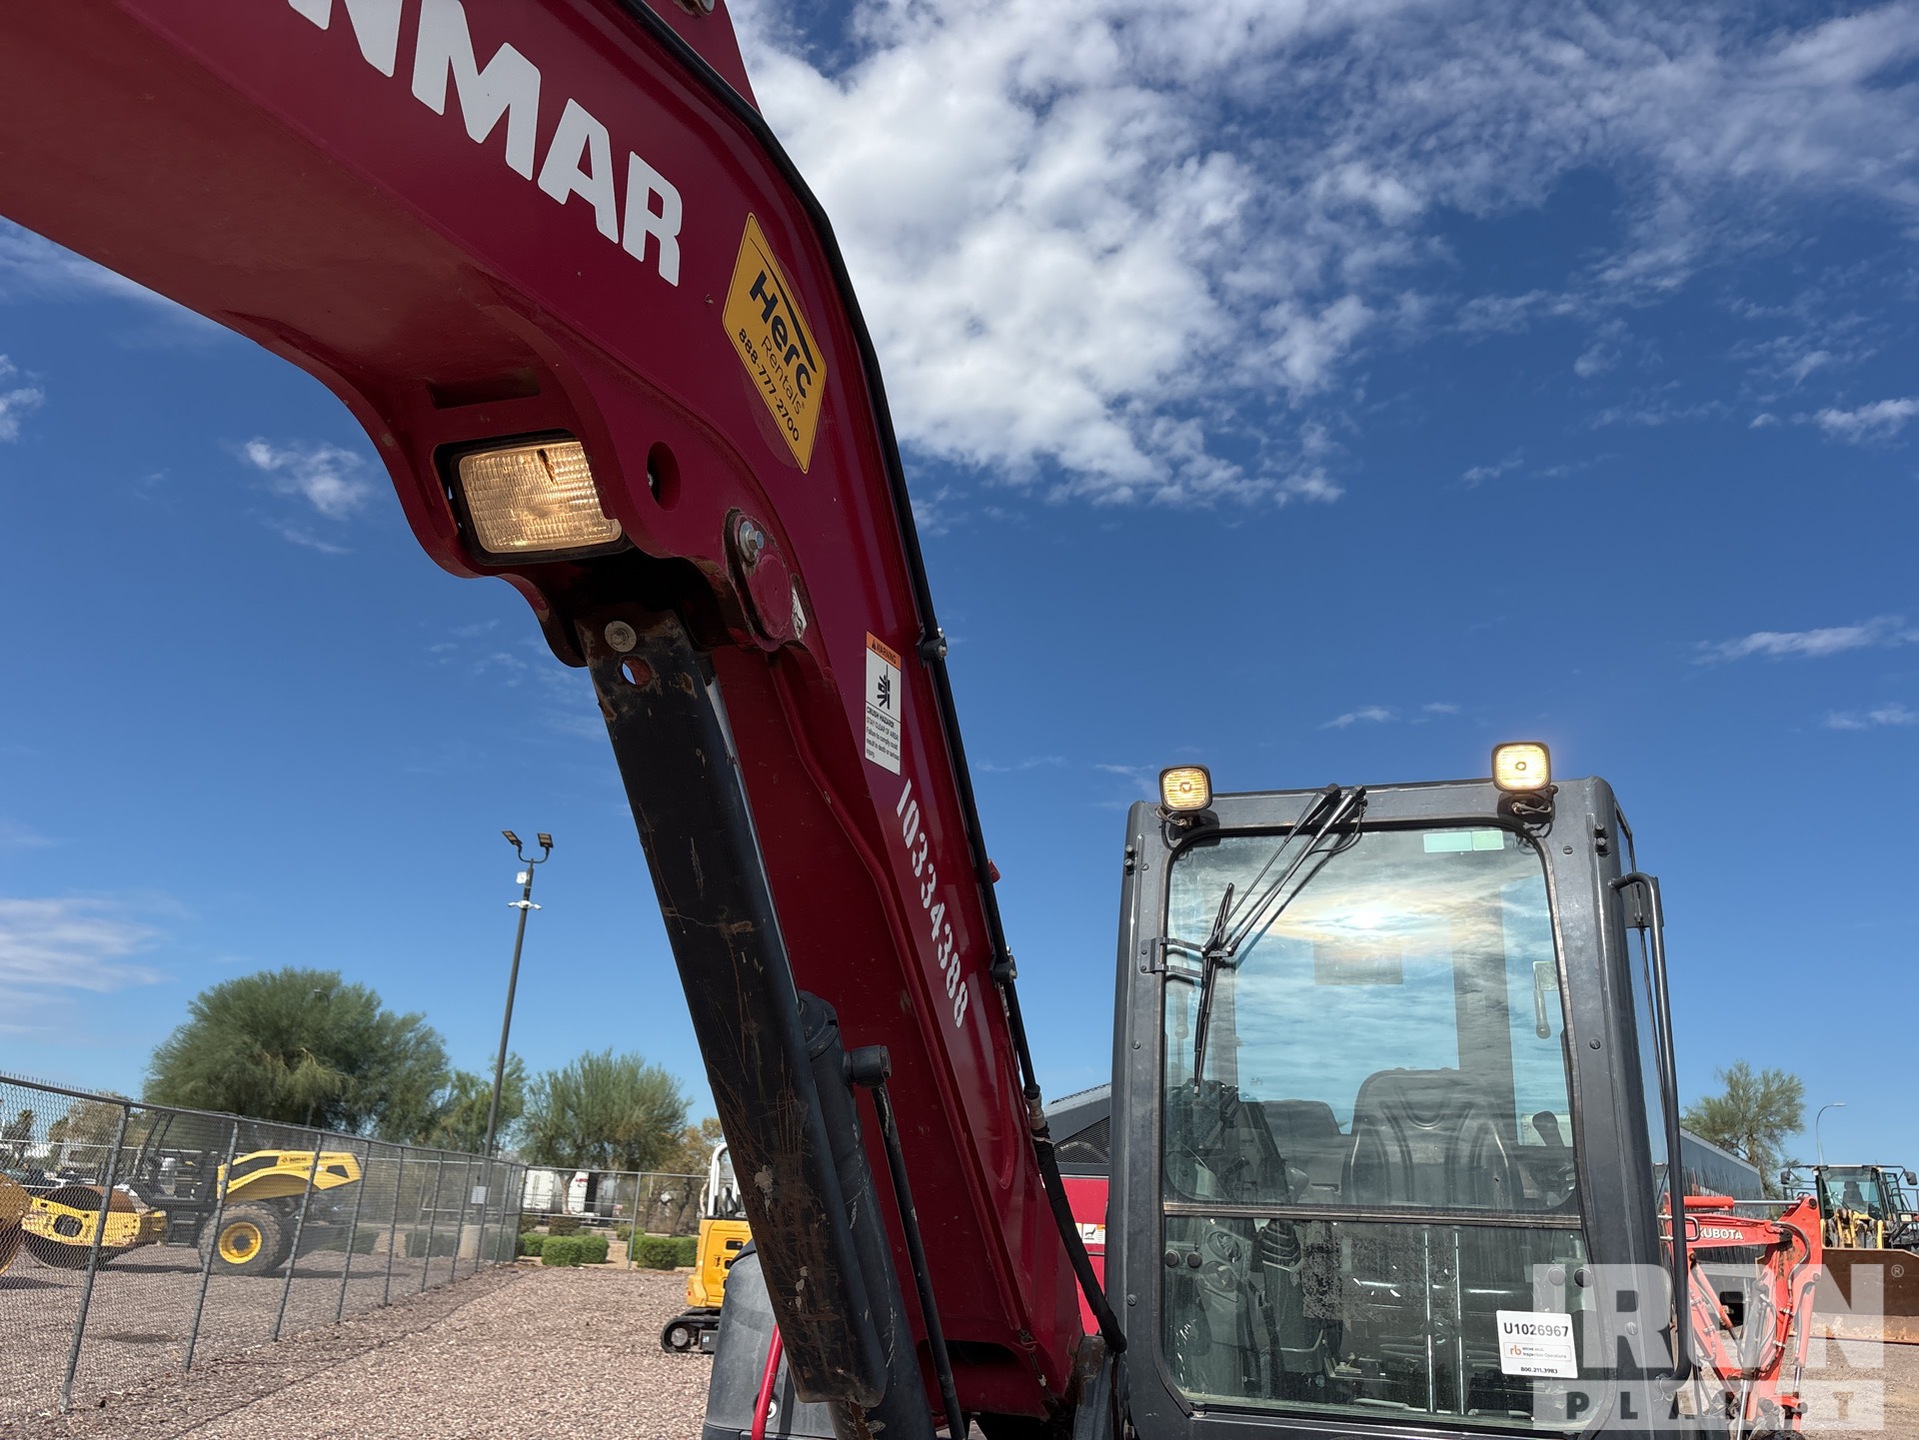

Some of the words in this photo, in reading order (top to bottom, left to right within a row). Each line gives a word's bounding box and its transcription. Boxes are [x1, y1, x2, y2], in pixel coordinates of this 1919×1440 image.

[749, 269, 812, 399] Herc
[738, 328, 800, 443] 888-777-2700
[761, 335, 803, 415] Rentals
[876, 643, 897, 665] WARNING
[896, 778, 968, 1028] 10334388
[1504, 1322, 1569, 1338] U1026967
[1510, 1344, 1522, 1356] rb
[1520, 1366, 1558, 1374] 800.211.3983
